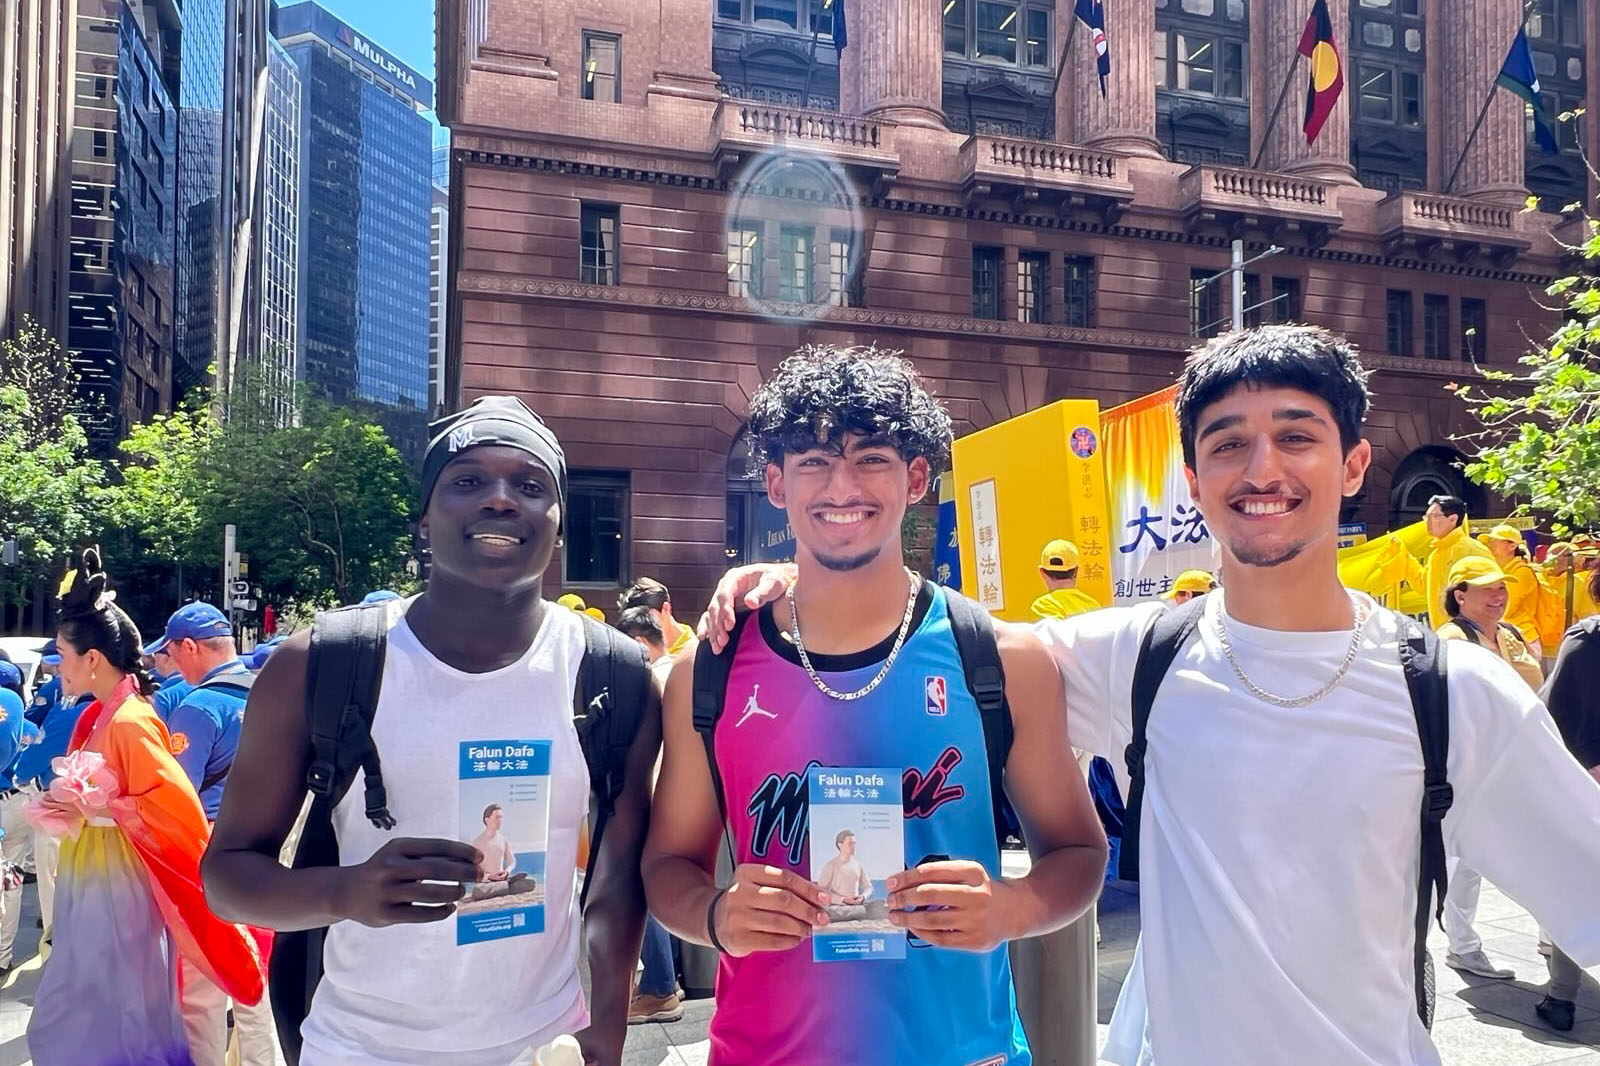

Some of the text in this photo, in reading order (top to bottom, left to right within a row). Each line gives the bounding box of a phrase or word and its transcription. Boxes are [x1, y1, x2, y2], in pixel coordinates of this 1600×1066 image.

[353, 36, 416, 89] MULPHA
[468, 745, 535, 759] Falun Dafa
[818, 774, 884, 786] Falun Dafa
[824, 788, 880, 798] 法輪大法
